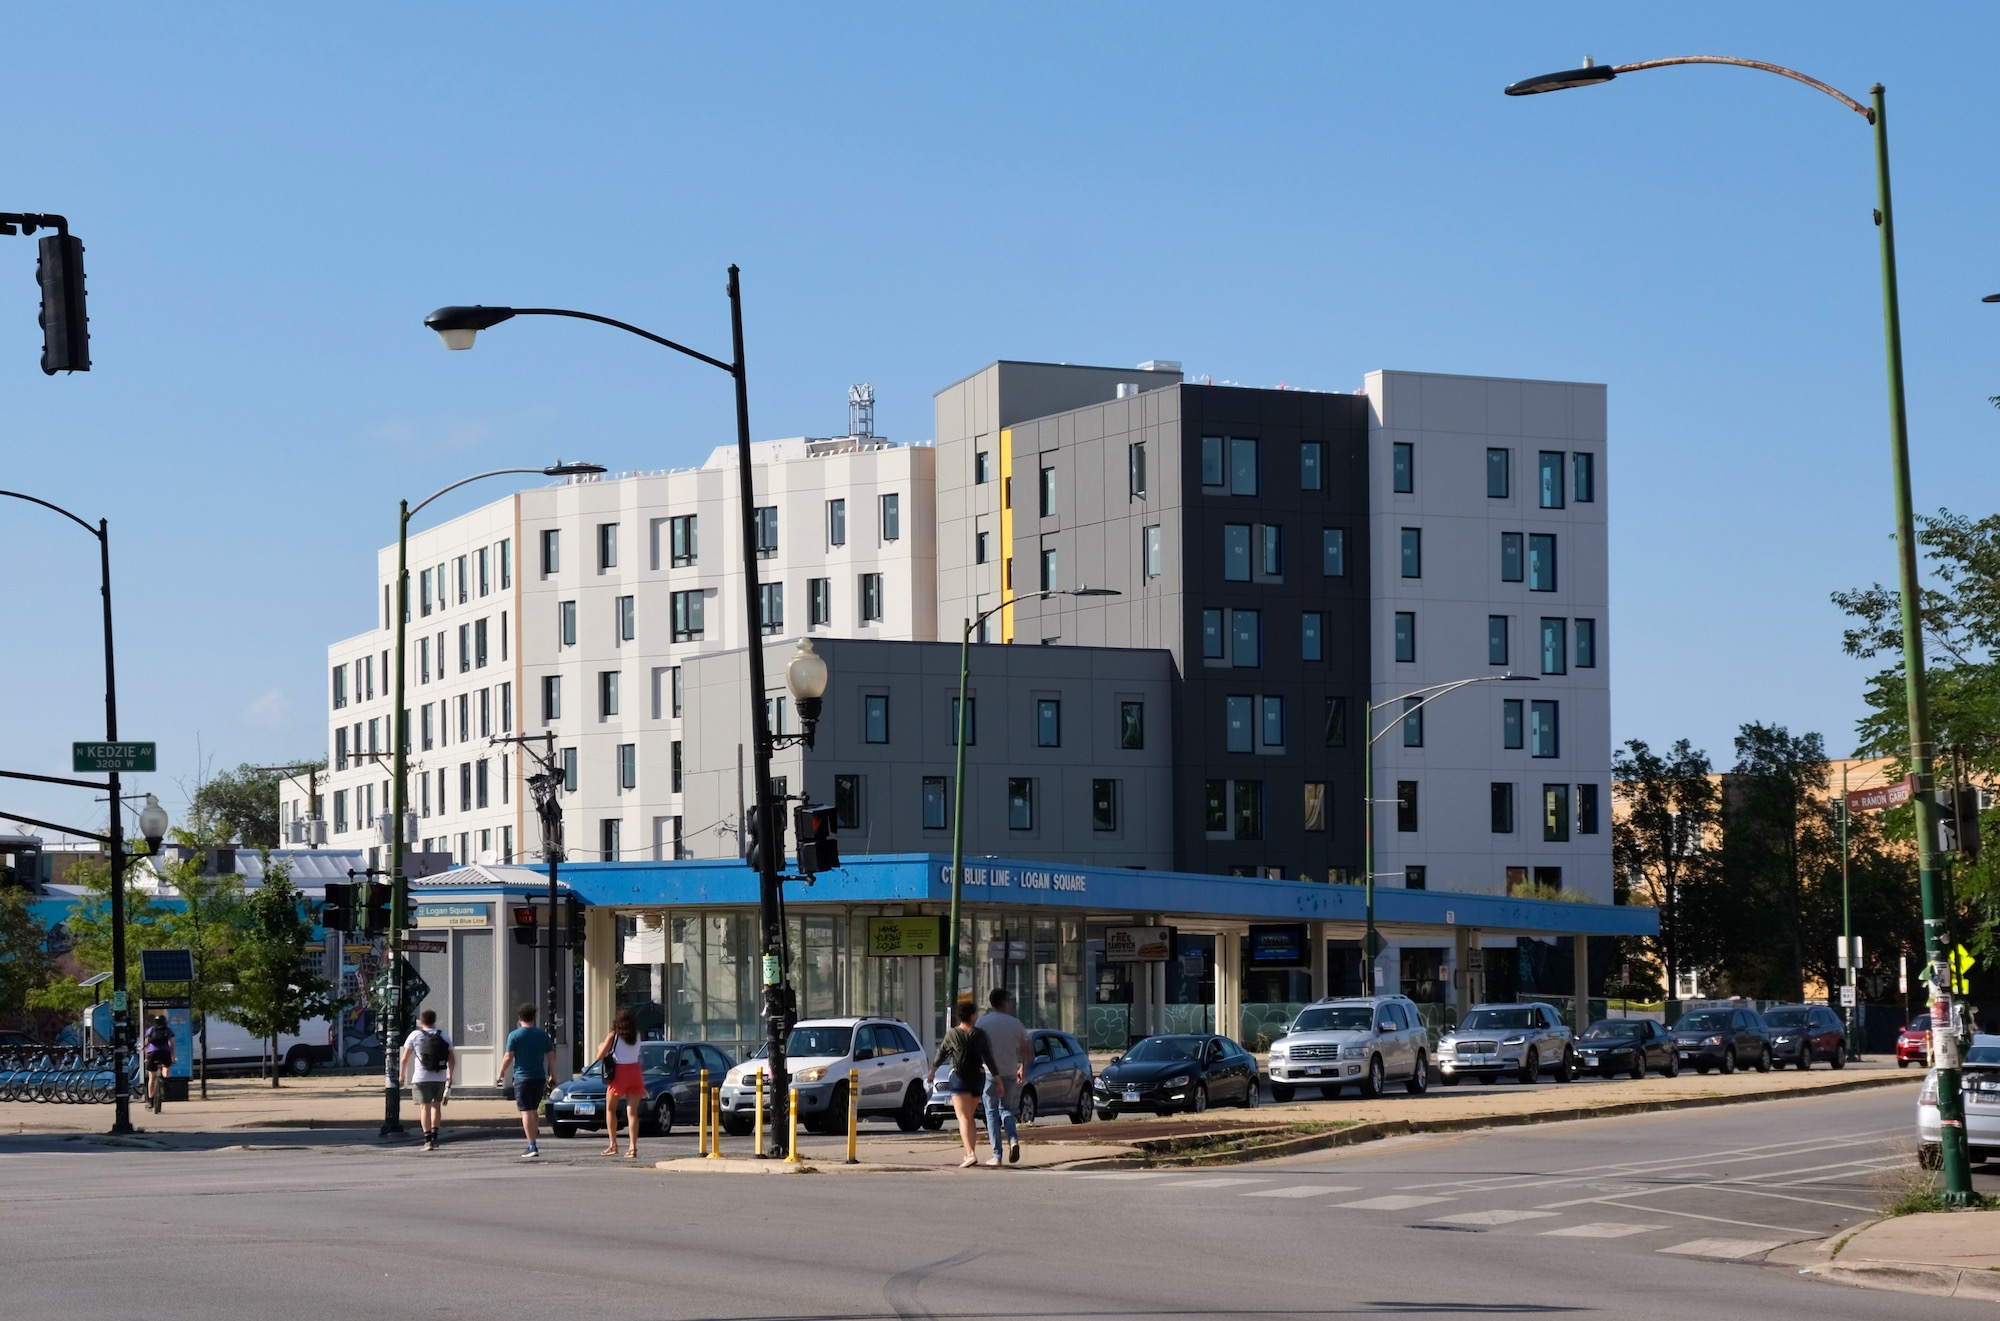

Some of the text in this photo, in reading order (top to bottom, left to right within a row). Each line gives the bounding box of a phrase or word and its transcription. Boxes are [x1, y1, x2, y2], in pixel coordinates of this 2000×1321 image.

[76, 746, 152, 758] N KEDZIE AV
[96, 760, 134, 768] 3200 W
[1861, 794, 1887, 807] RAMON
[964, 867, 987, 885] BLUE
[990, 869, 1010, 887] LINE
[1020, 871, 1050, 889] LOGAN
[1052, 873, 1086, 892] SQUARE
[425, 907, 474, 916] Logan Square
[1111, 934, 1132, 942] FREE
